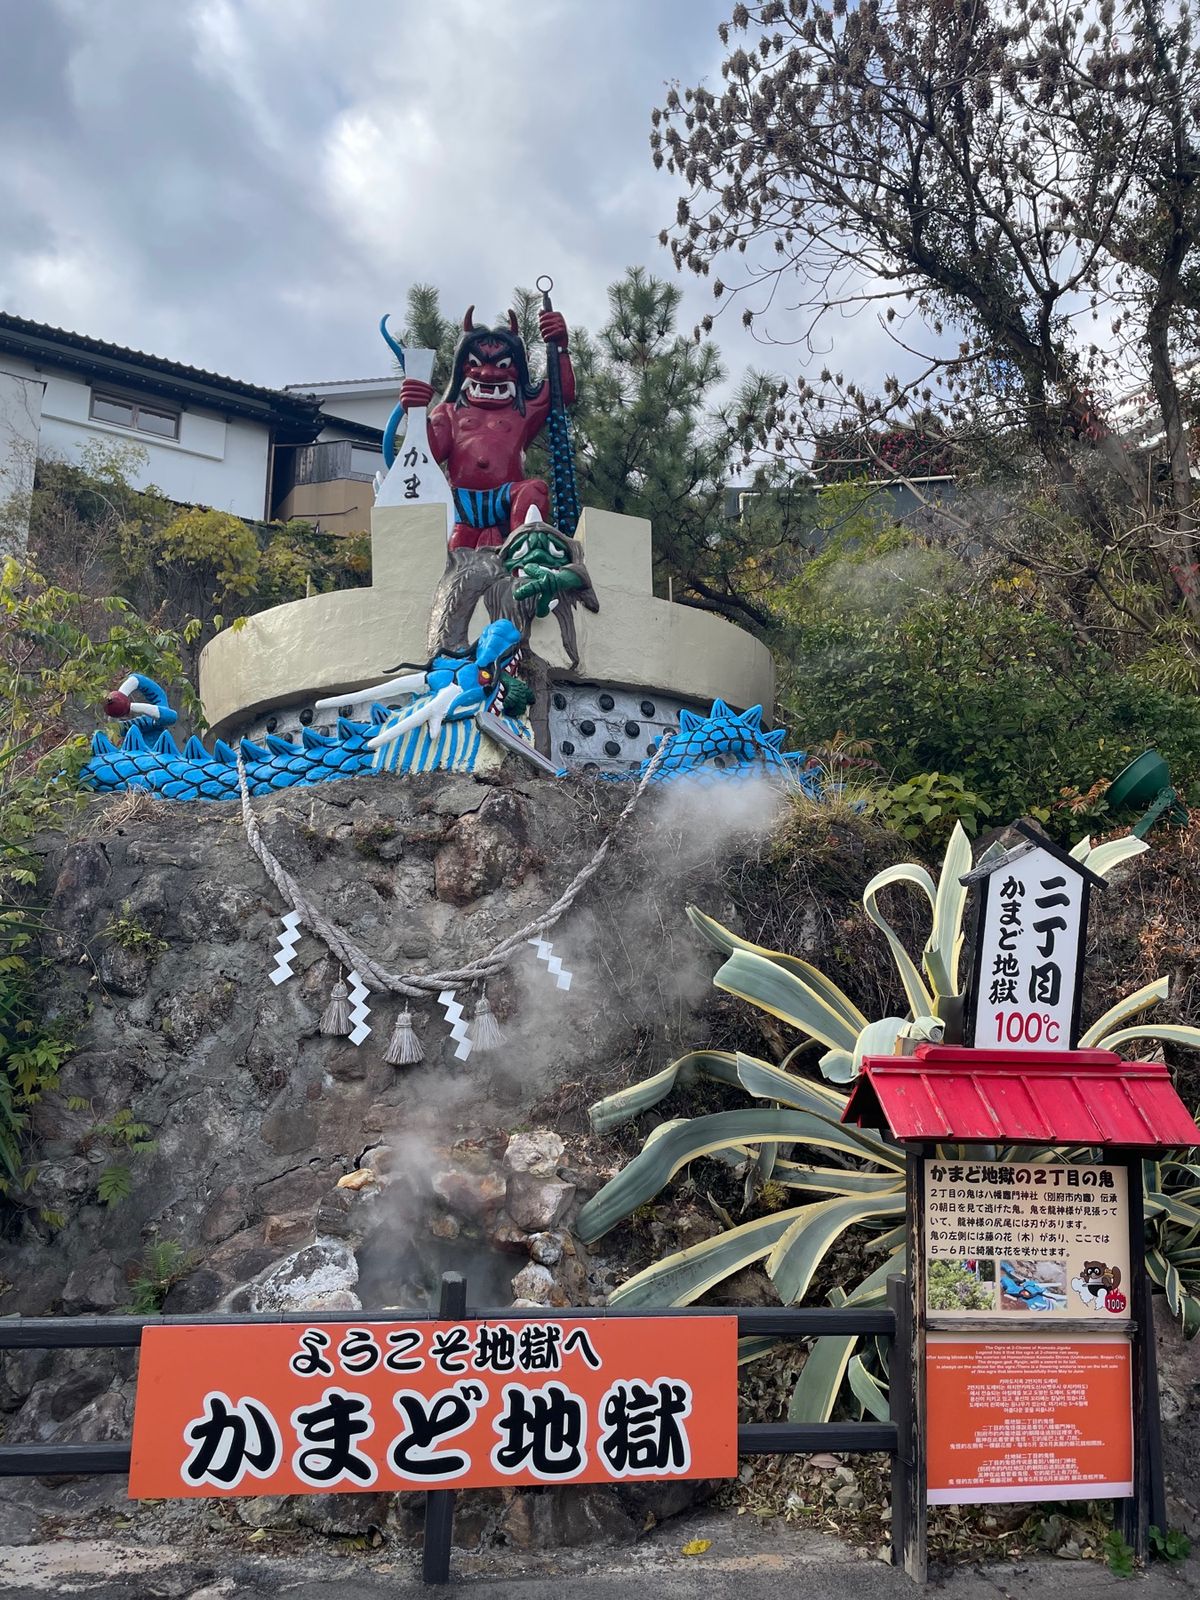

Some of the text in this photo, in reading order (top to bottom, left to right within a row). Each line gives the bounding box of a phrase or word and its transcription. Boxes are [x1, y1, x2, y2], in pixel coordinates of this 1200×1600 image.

[403, 446, 428, 499] かま
[988, 875, 1026, 1005] かまど地獄
[1028, 875, 1071, 1006] 二丁目
[292, 1325, 600, 1374] ようこそ地獄へ
[183, 1381, 690, 1486] かまど地獄
